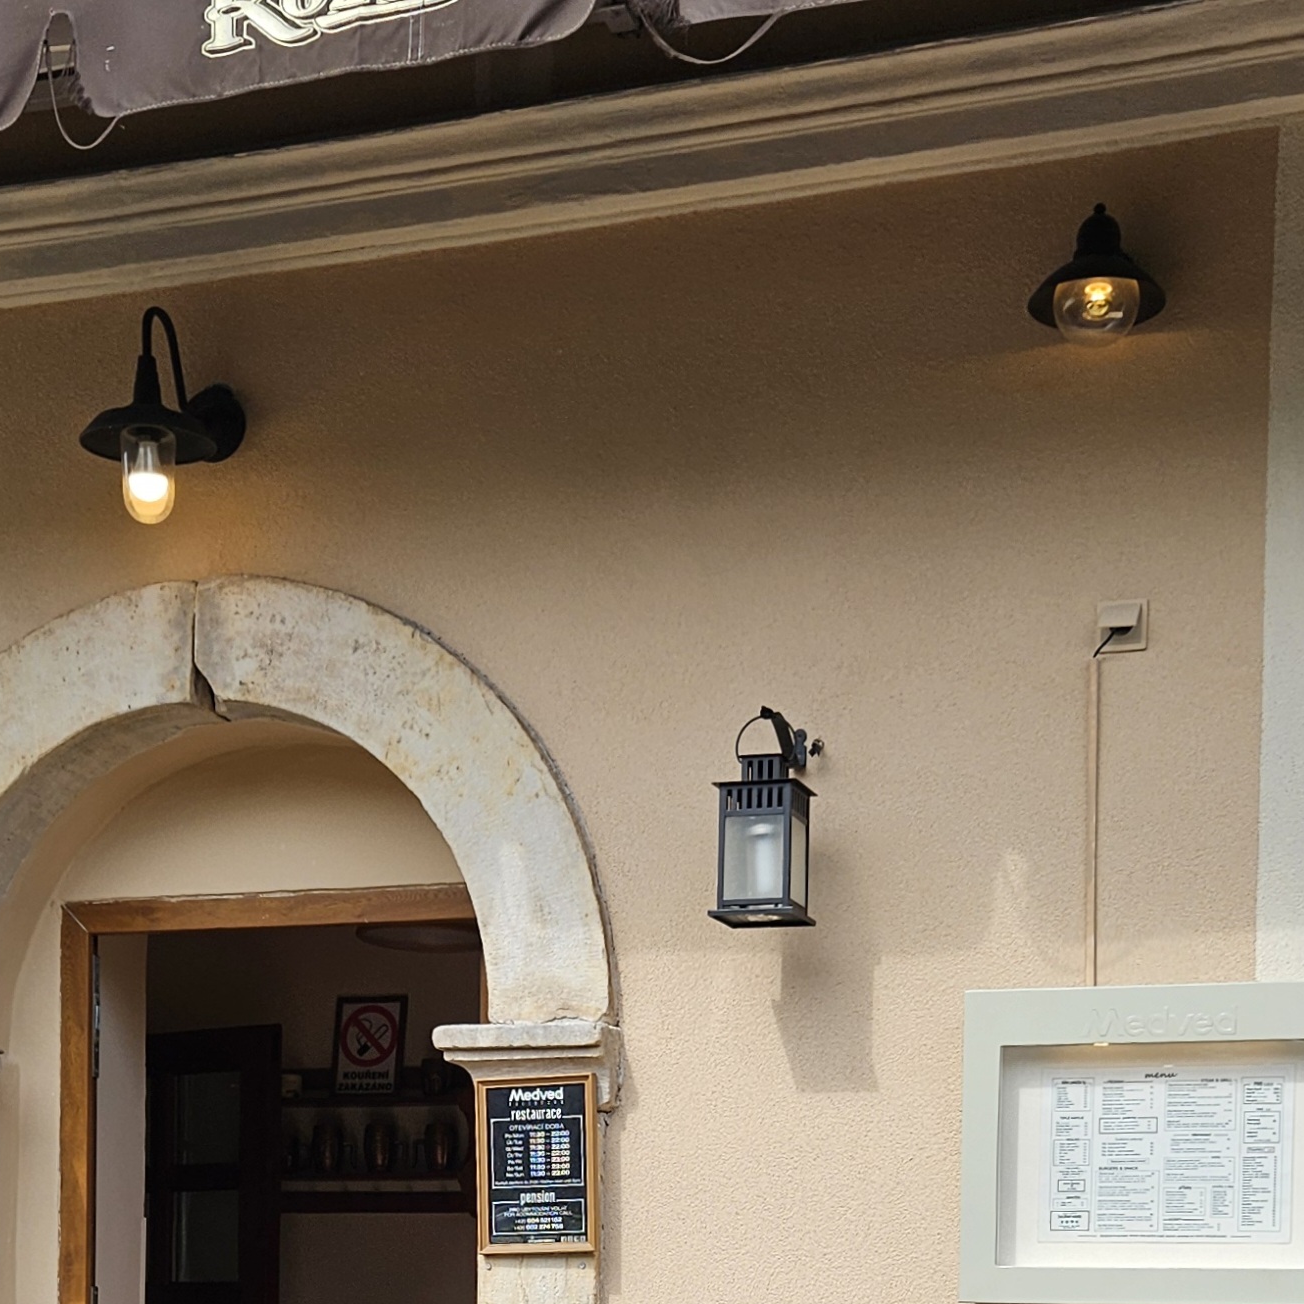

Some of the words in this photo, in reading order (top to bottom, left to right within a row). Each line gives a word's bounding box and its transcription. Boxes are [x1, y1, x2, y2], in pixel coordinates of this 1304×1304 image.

[1083, 1005, 1239, 1038] Medved
[343, 1069, 389, 1080] KOUŘENÍ
[1144, 1071, 1178, 1079] menu
[508, 1087, 564, 1101] Medved
[510, 1108, 562, 1121] restaurace
[545, 1122, 565, 1130] DOBA
[520, 1190, 556, 1205] pension
